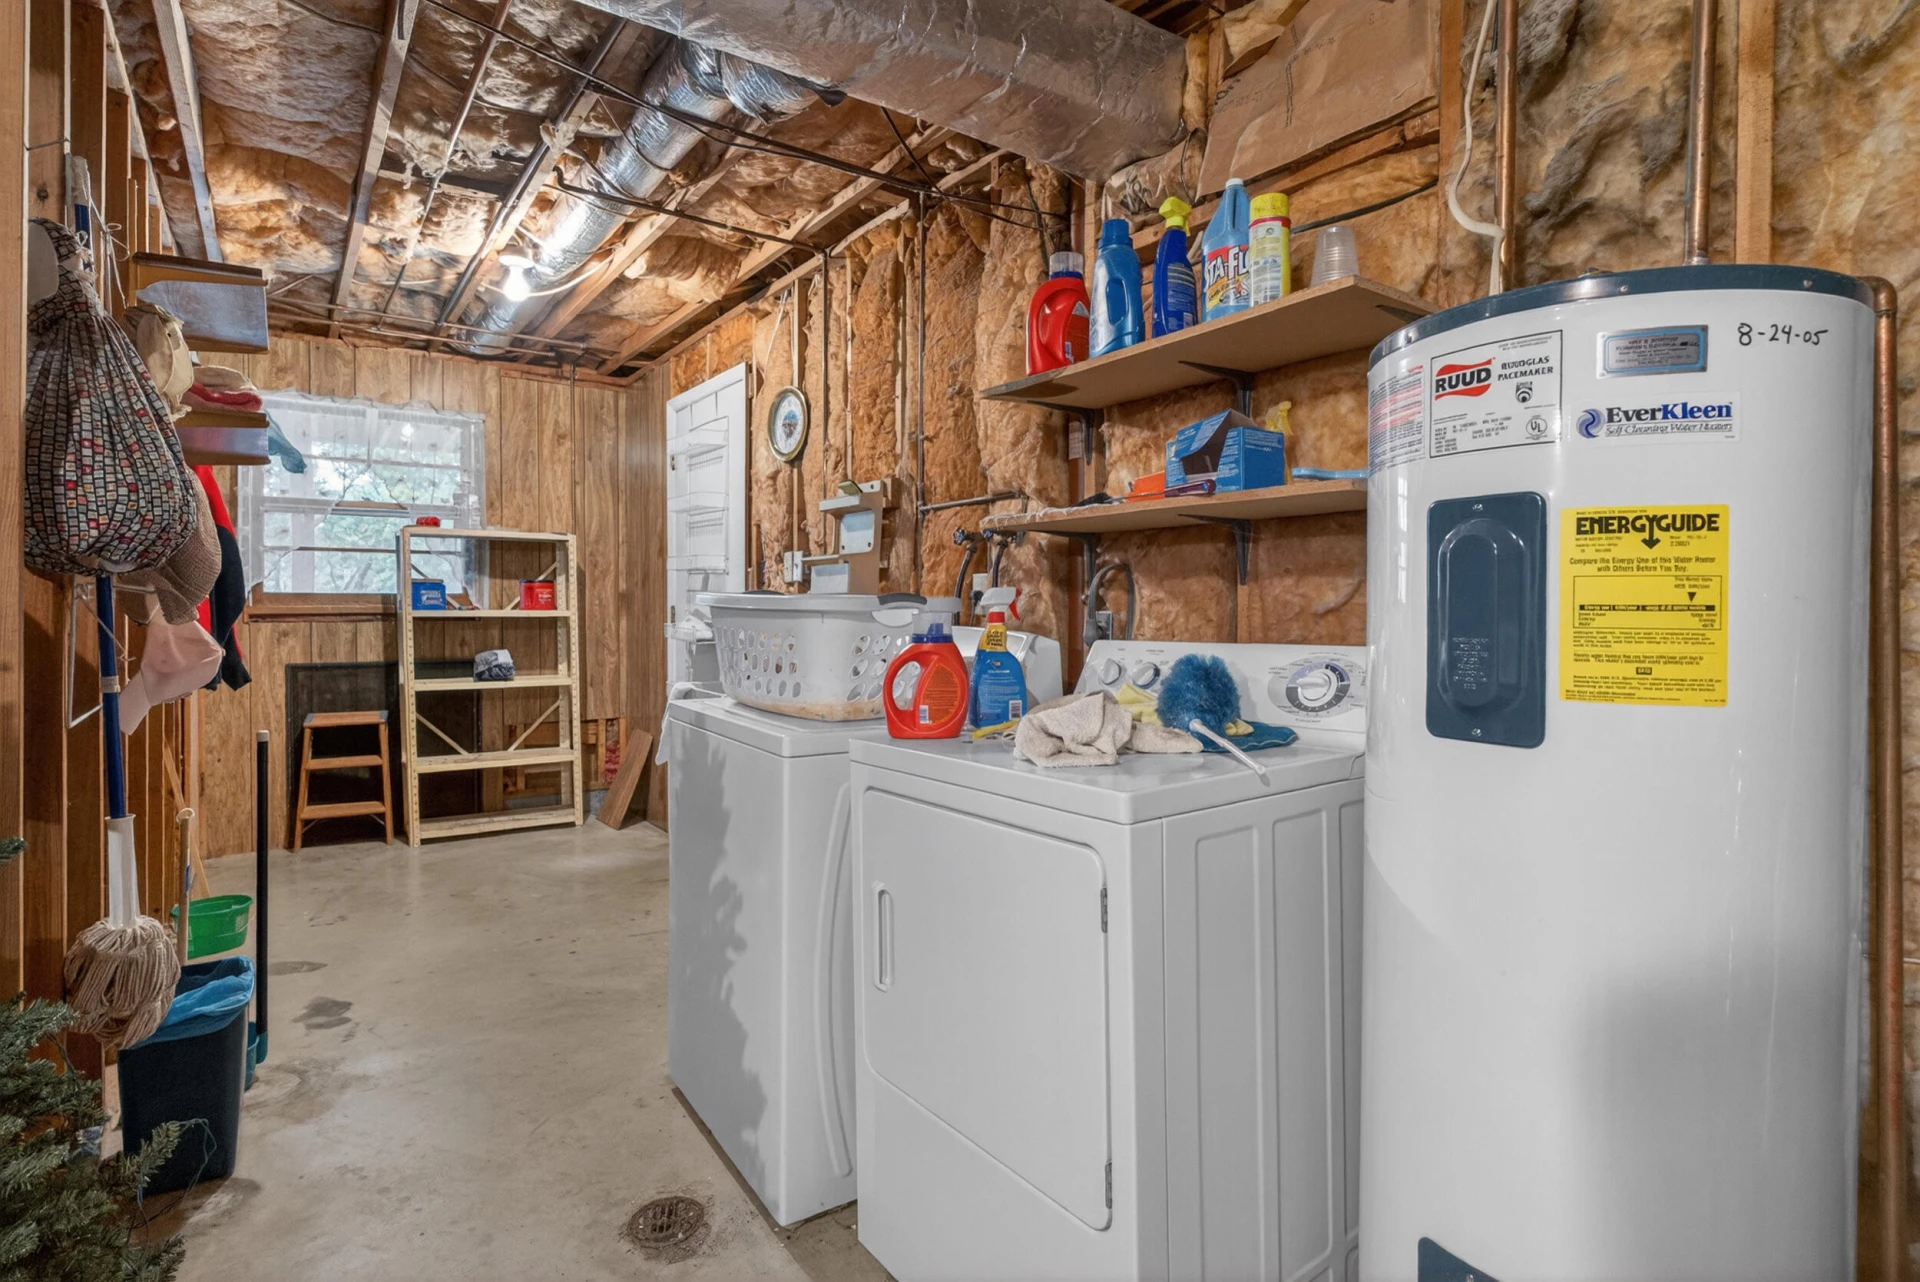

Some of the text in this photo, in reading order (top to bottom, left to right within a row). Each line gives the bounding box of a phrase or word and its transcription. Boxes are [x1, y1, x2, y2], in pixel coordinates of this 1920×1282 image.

[1738, 322, 1829, 346] 8-24-05
[1435, 367, 1492, 393] RUUD
[1497, 366, 1554, 381] PACEMAKER
[1606, 402, 1733, 423] EverKleen
[1576, 513, 1720, 535] ENERGYGUIDE
